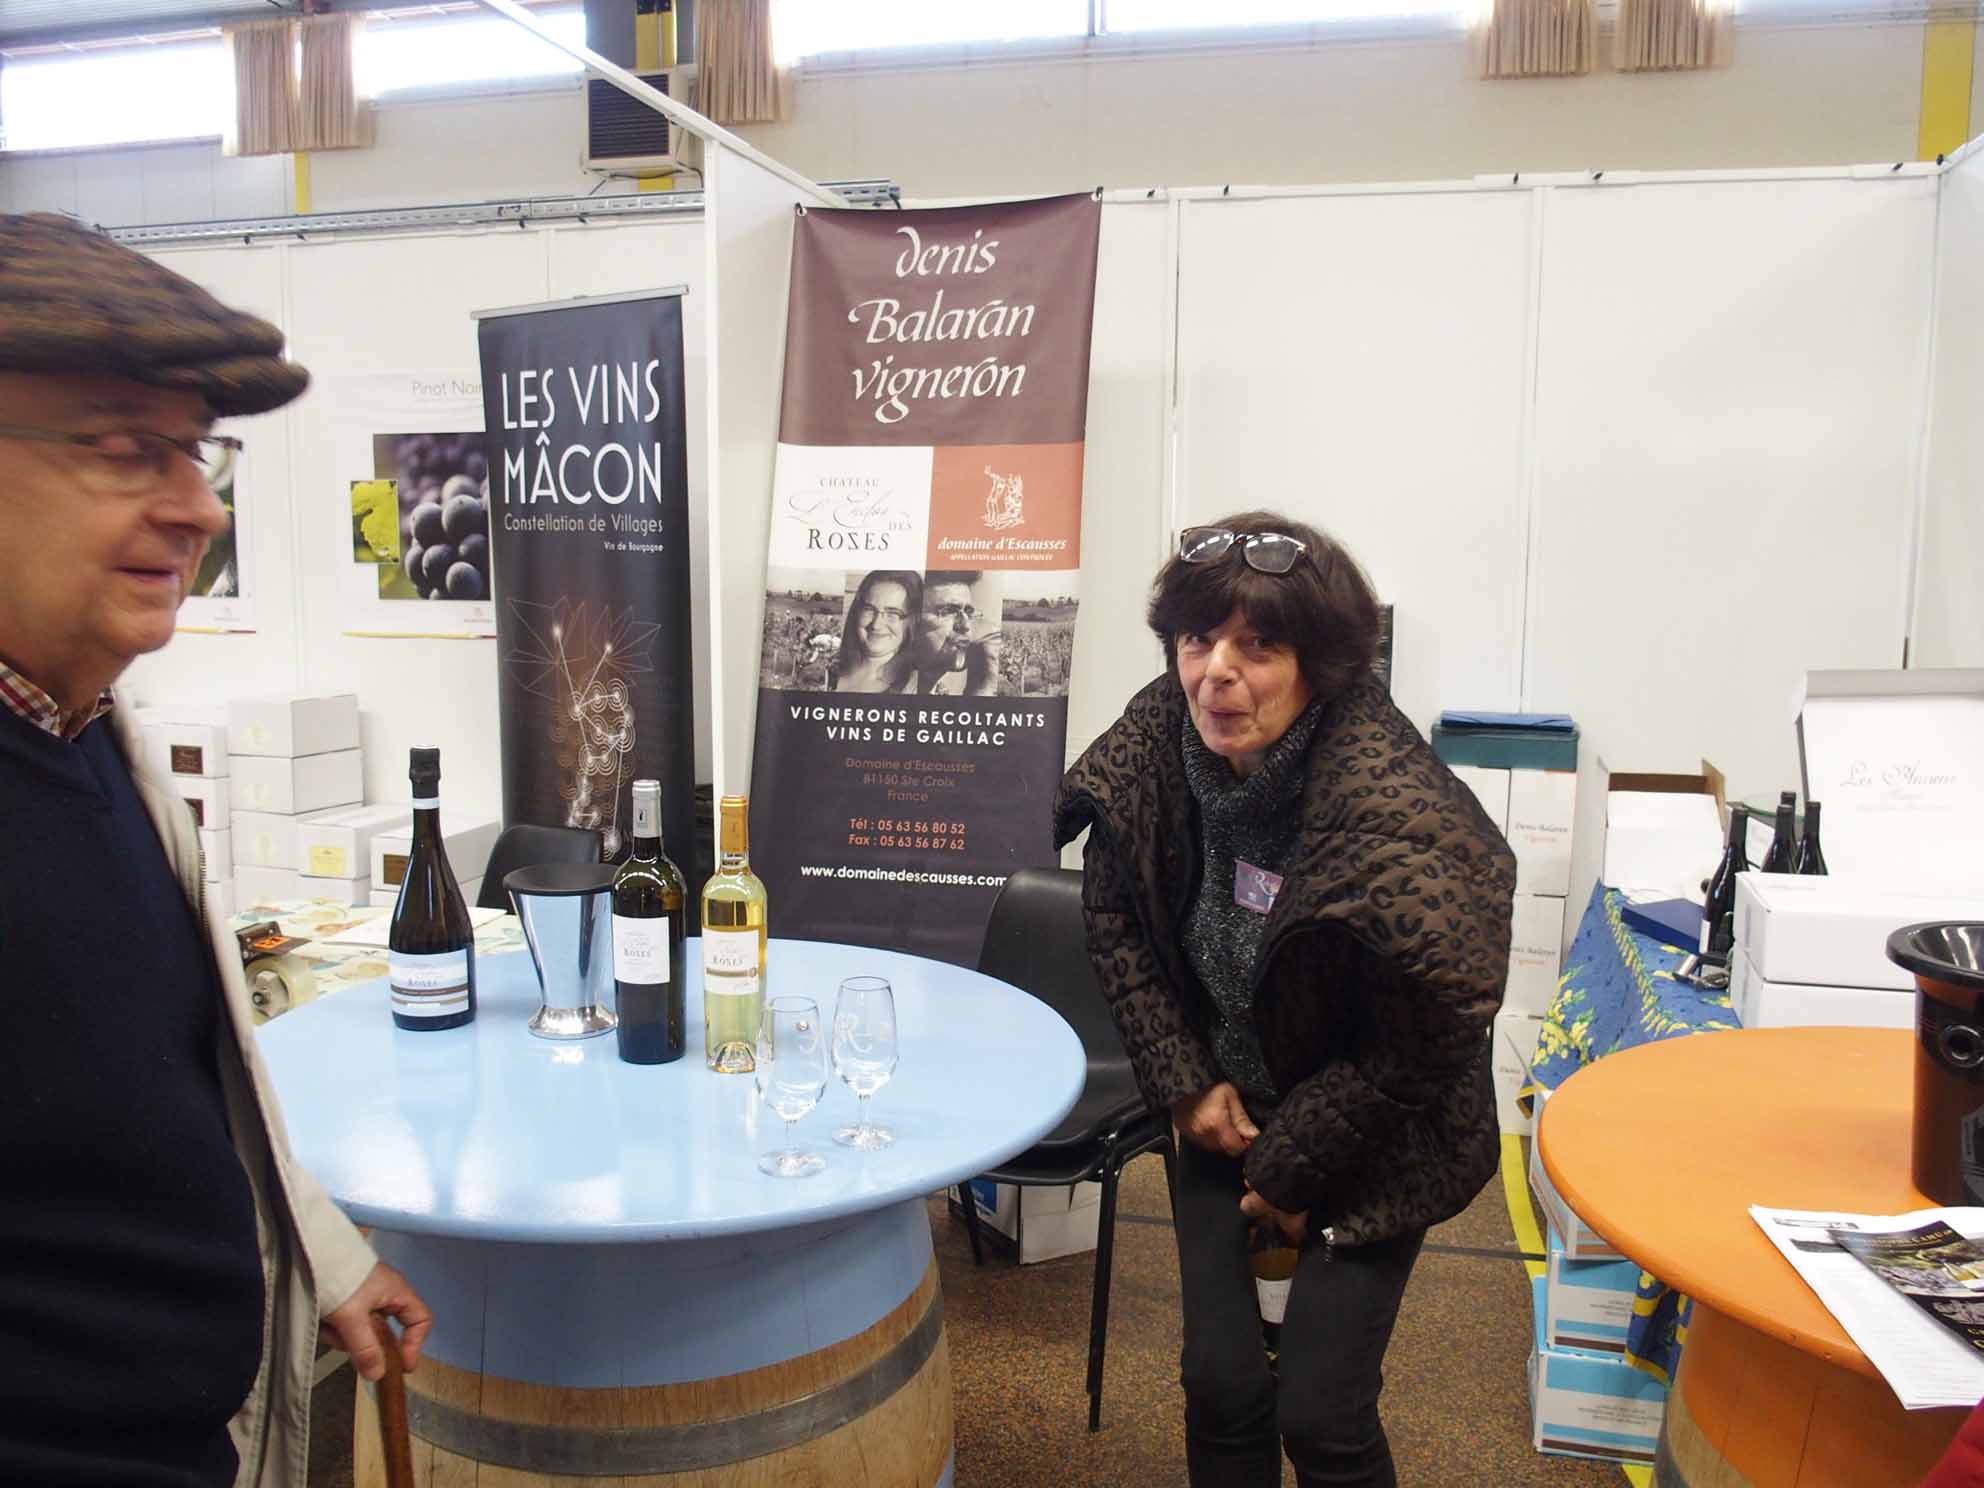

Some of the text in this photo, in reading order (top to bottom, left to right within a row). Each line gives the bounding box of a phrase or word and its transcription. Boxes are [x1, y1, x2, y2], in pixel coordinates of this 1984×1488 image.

[895, 226, 1000, 277] denis
[411, 380, 448, 396] Pinot
[501, 359, 660, 430] LES VINS
[503, 431, 663, 505] MÂCON
[503, 513, 664, 536] Constellation de Villages
[603, 541, 664, 553] Vin de Bourgogne
[936, 536, 1068, 551] domaine d'Escausses
[790, 705, 1046, 728] VIGNERONS RECOLTANTS
[826, 726, 1007, 746] VINS DE GAILLAC
[845, 757, 977, 774] Domaine d'Escausses
[922, 775, 955, 788] Croix
[887, 789, 929, 802] France
[849, 818, 868, 830] Tél
[877, 820, 893, 831] 05
[896, 820, 911, 833] 63
[914, 821, 929, 834] 56
[932, 822, 948, 835] 80
[950, 823, 966, 836] 52
[849, 834, 870, 846] Fax
[880, 835, 895, 847] 05
[897, 835, 912, 848] 63
[915, 836, 930, 849] 56
[932, 837, 948, 850] 87
[950, 838, 966, 851] 62
